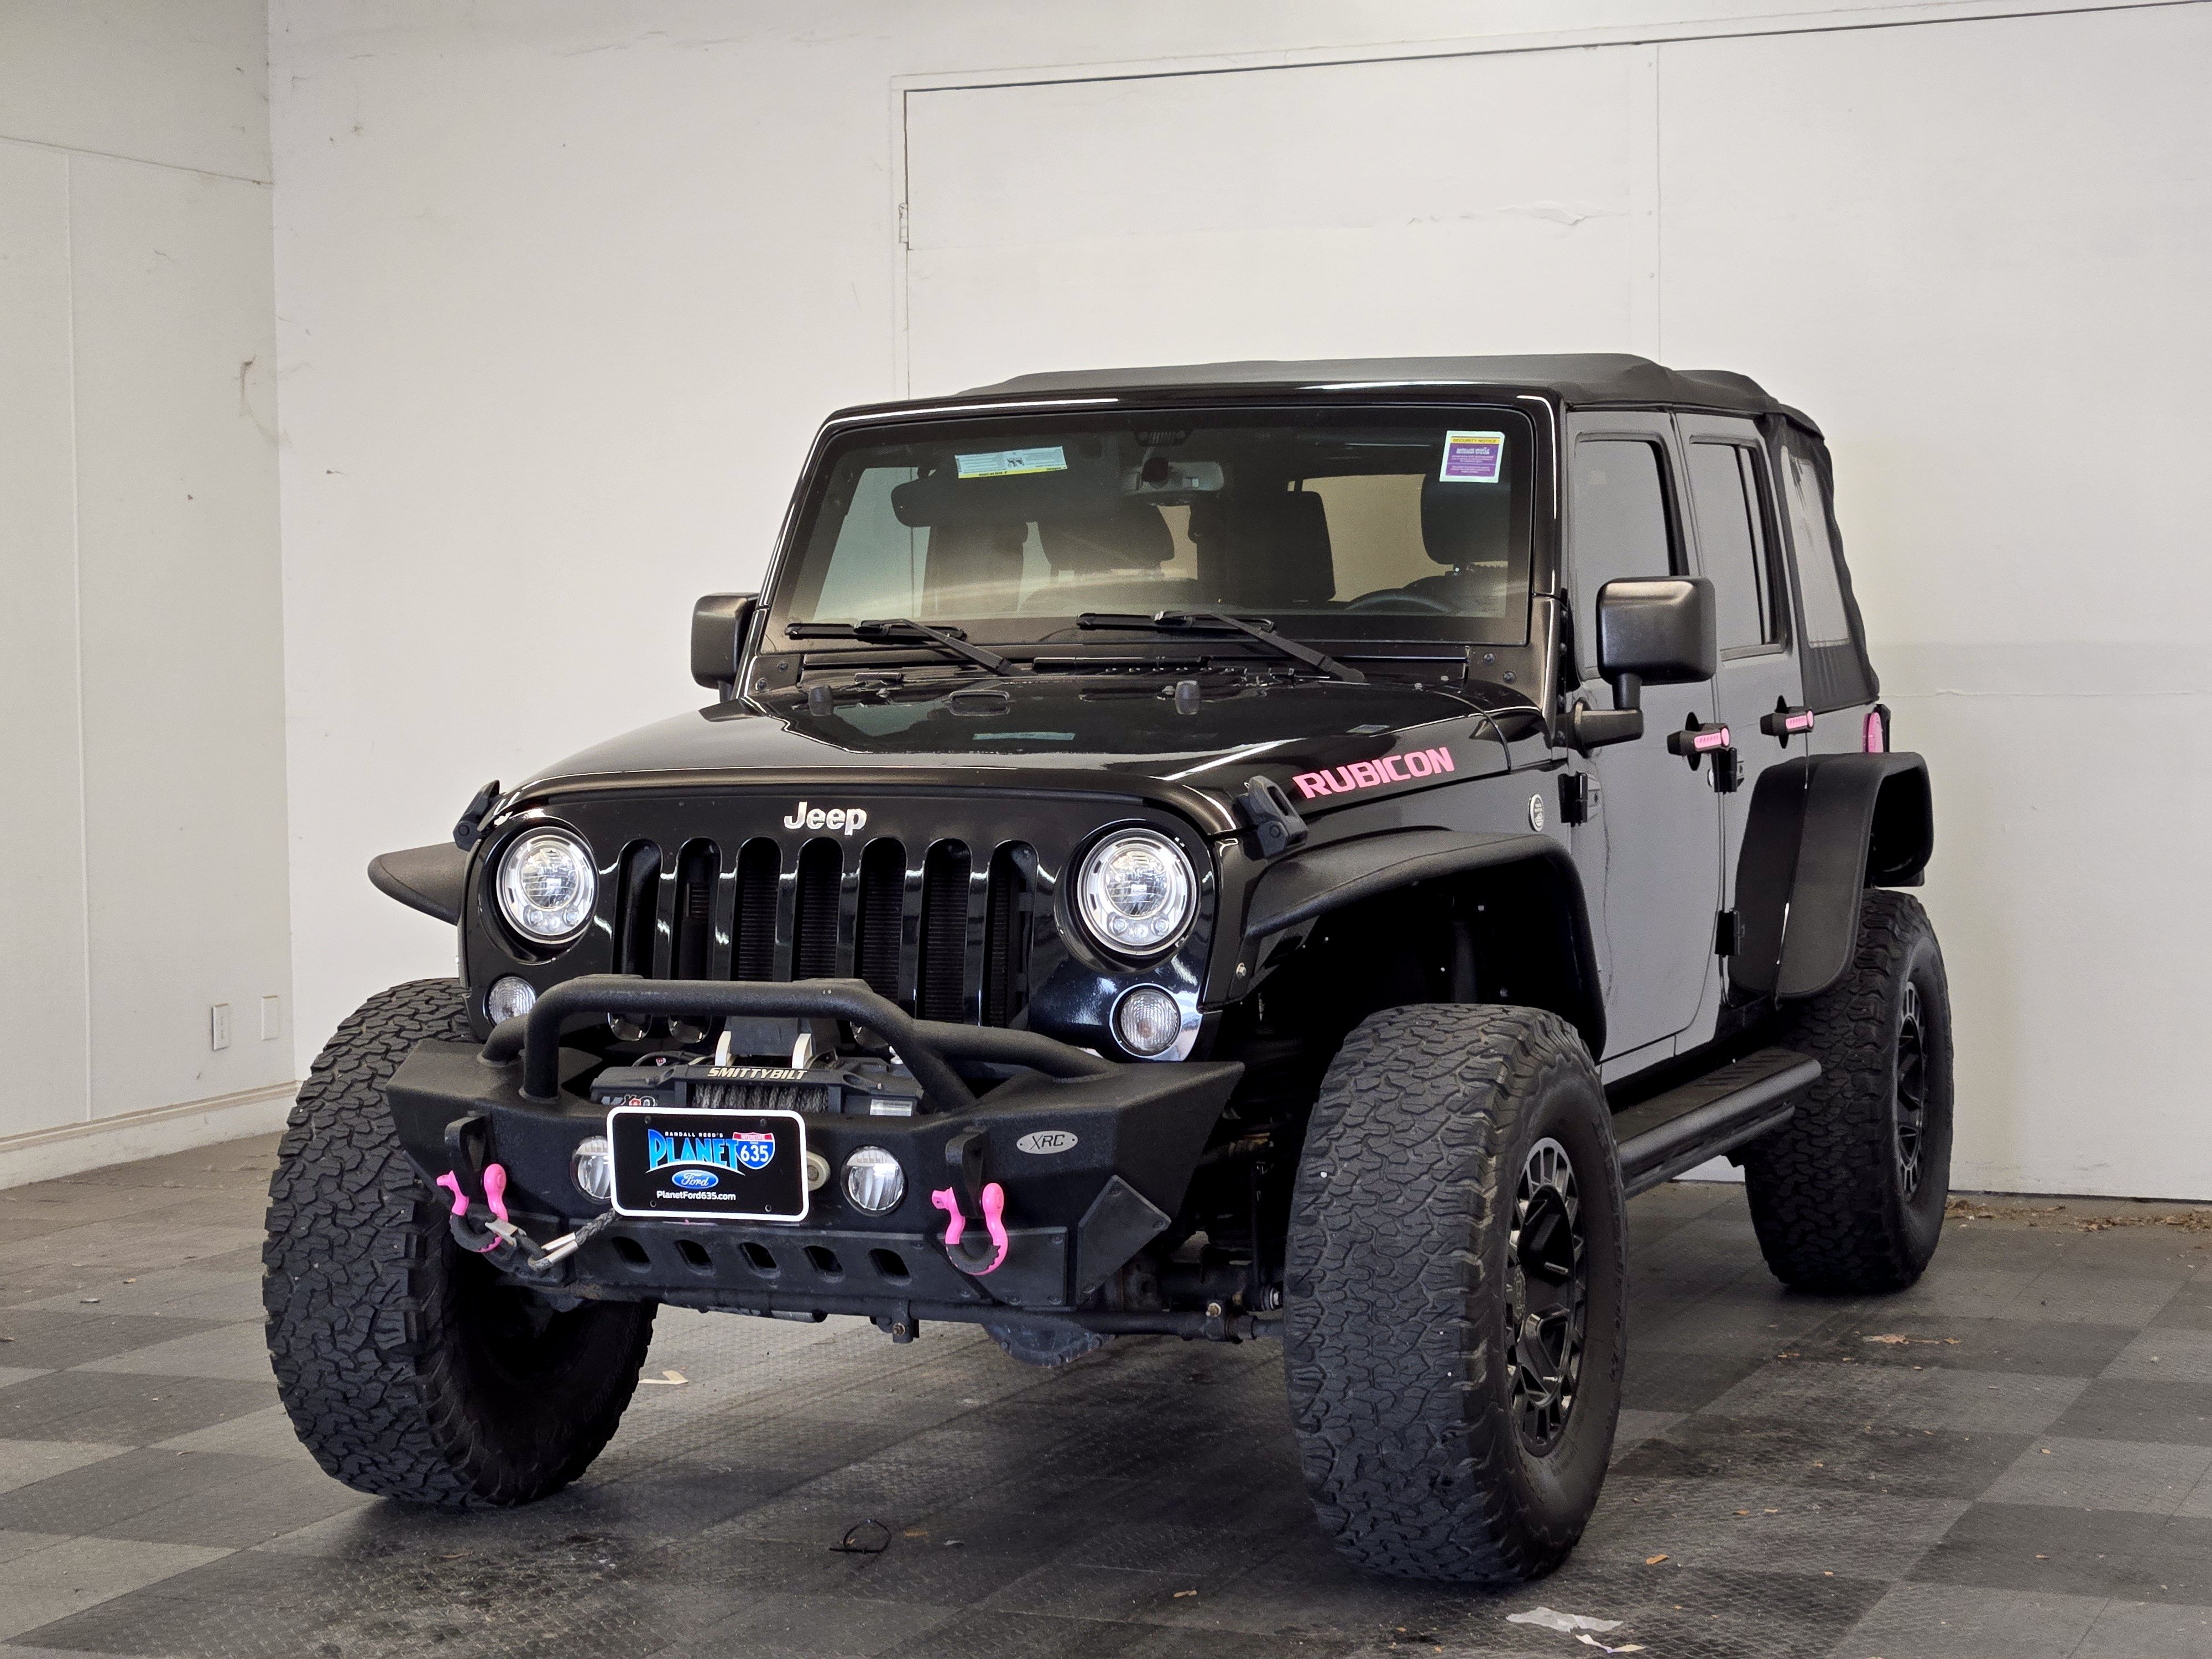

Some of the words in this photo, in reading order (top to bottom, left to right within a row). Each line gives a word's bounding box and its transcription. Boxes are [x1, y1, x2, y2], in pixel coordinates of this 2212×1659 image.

[1292, 747, 1455, 799] RUBICON
[784, 801, 867, 836] Jeep
[707, 1067, 807, 1080] SMITTYBILT
[648, 1129, 739, 1171] PLANET
[1029, 1134, 1065, 1150] XRC
[740, 1144, 769, 1162] 635
[681, 1173, 710, 1187] Ford
[656, 1191, 736, 1201] PlanetFord635.com
